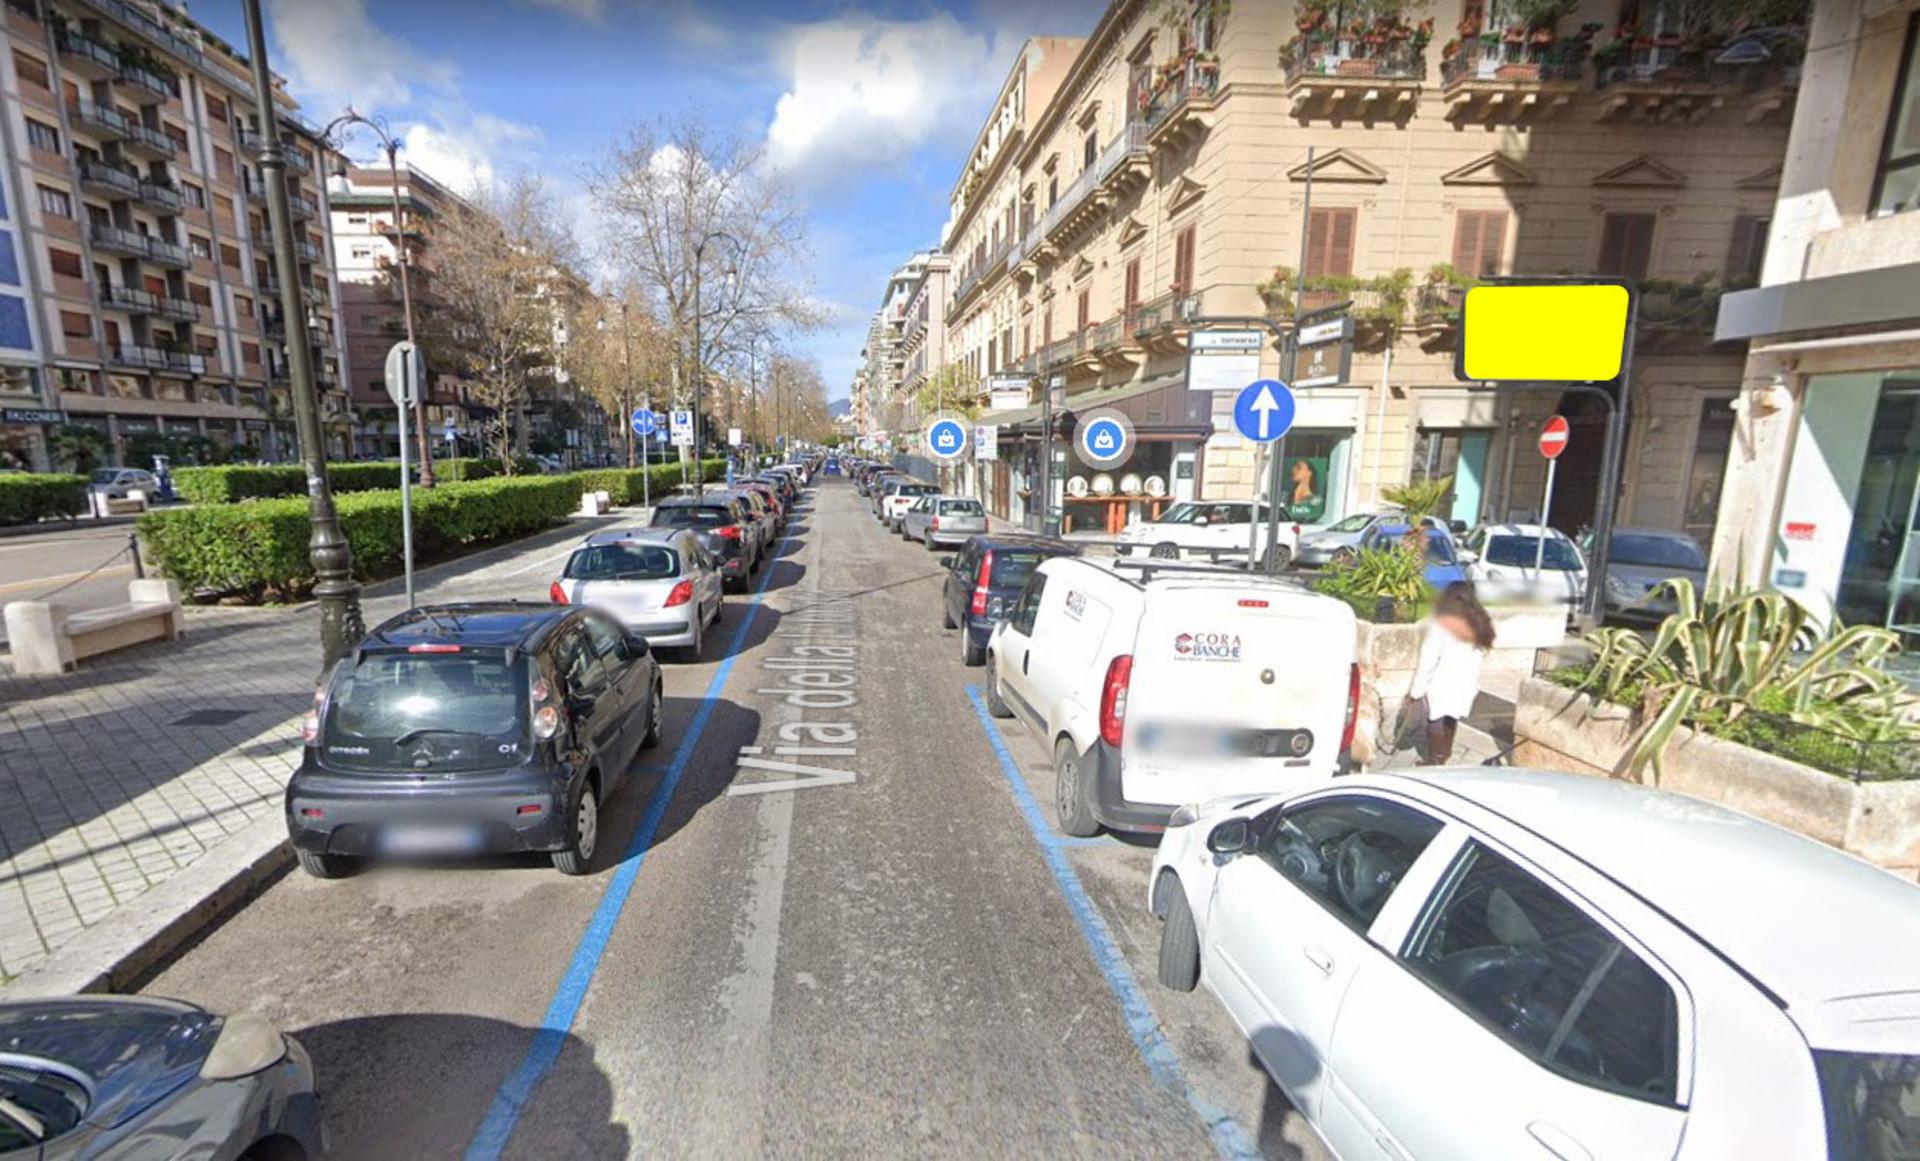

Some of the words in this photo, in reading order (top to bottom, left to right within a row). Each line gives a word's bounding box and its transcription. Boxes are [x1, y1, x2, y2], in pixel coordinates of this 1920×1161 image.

[1194, 633, 1241, 646] CORA
[1192, 645, 1241, 658] BANCHE
[498, 743, 518, 754] C1
